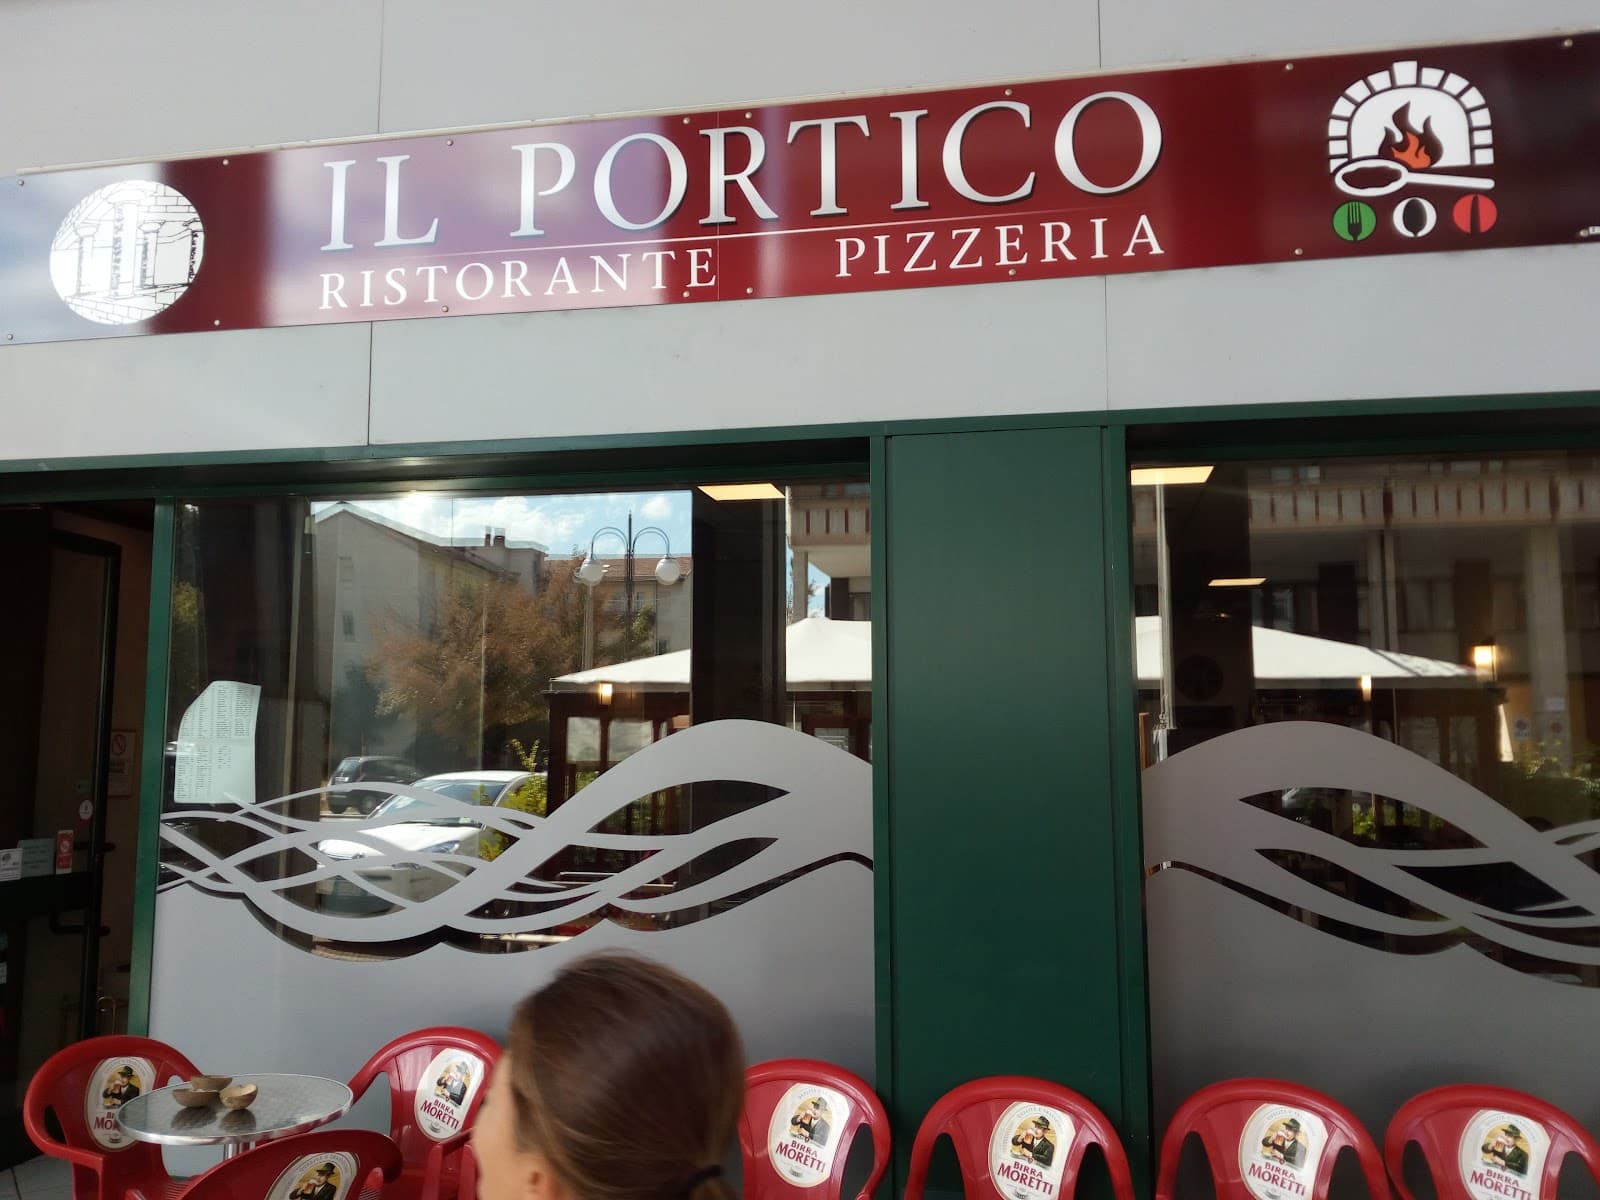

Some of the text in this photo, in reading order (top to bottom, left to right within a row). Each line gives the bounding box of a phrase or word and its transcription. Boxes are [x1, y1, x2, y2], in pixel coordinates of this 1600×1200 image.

[321, 91, 1162, 251] IL PORTICO
[319, 214, 1165, 310] RISTORANTE PIZZERIA
[420, 1100, 460, 1130] MORETTI
[433, 1099, 455, 1116] BIRRA
[776, 1141, 827, 1174] MORETTI
[790, 1140, 818, 1158] BIRRA
[997, 1162, 1054, 1196] MORETTI
[1013, 1161, 1043, 1179] BIRRA
[1248, 1163, 1307, 1197] MORETTI
[1264, 1162, 1296, 1180] BIRRA
[1486, 1168, 1520, 1187] BIRRA
